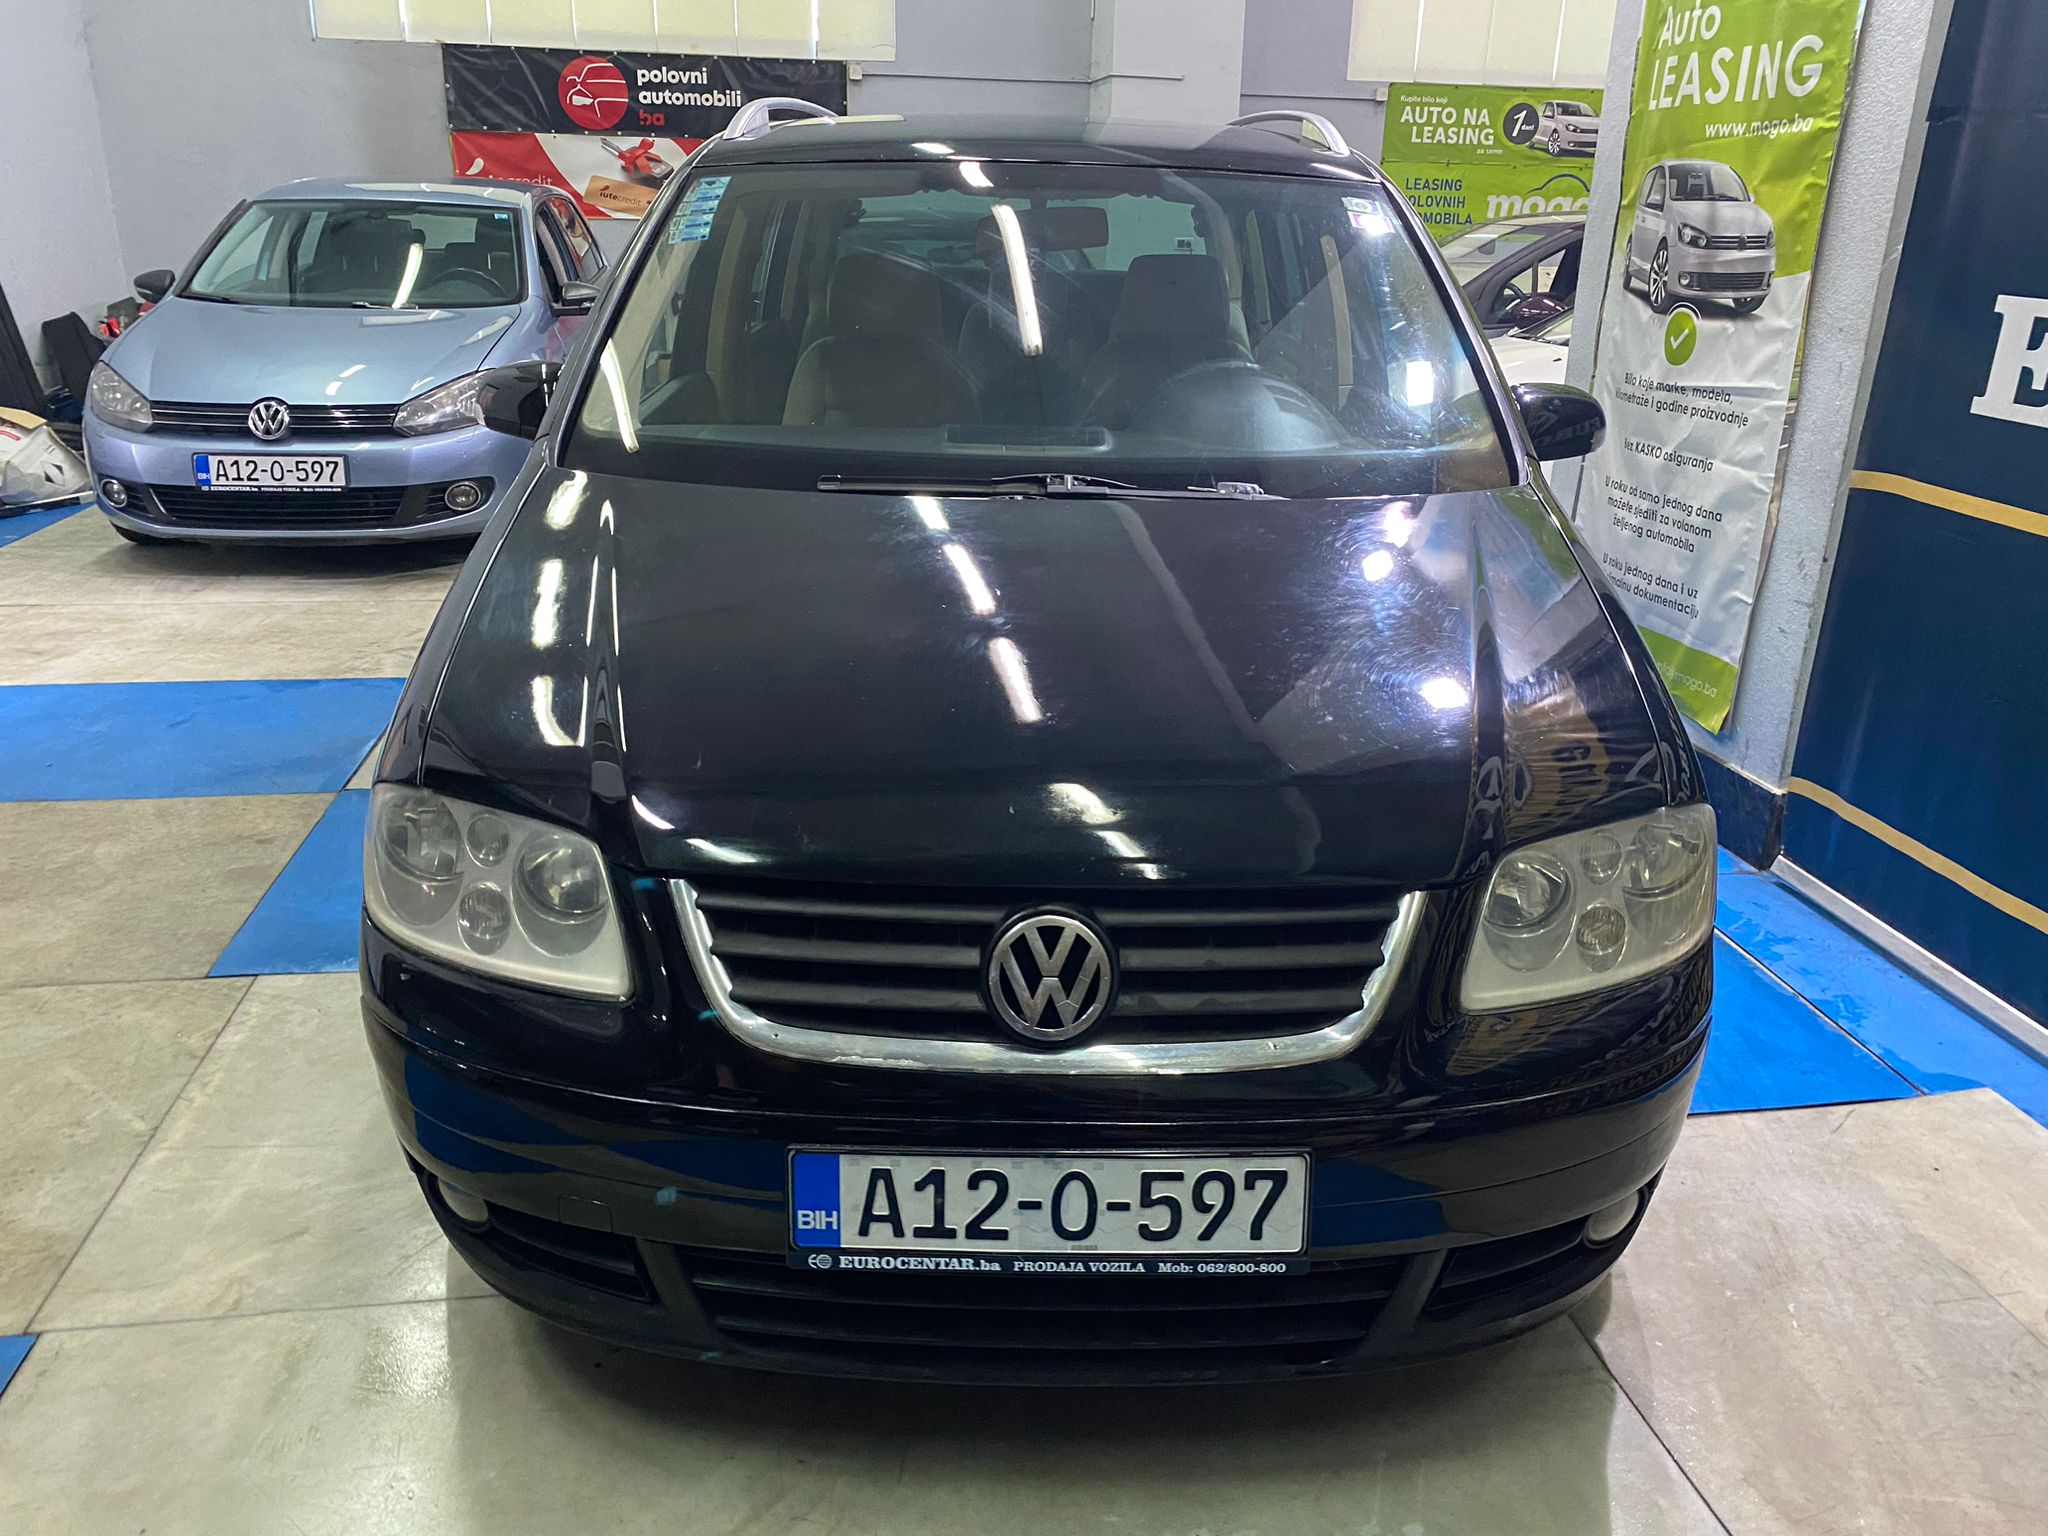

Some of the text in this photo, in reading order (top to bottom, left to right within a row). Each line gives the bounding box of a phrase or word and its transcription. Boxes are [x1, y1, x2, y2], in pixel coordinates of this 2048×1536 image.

[637, 66, 708, 86] polovni
[1648, 35, 1824, 110] LEASING
[638, 89, 742, 107] automobili
[1400, 106, 1490, 125] AUTO NA
[1511, 109, 1527, 137] 1
[1705, 114, 1814, 139] www.mogo.ba
[1411, 126, 1494, 146] LEASING
[1405, 177, 1463, 191] LEASING
[1408, 195, 1466, 209] OLOVNIH
[1638, 375, 1654, 391] koje
[1655, 381, 1689, 398] marke,
[1692, 387, 1733, 405] modela,
[1655, 399, 1689, 415] godine
[1690, 406, 1749, 428] proizvodnje
[1635, 441, 1662, 459] KASKO
[1663, 450, 1713, 473] osiguranja
[1610, 479, 1628, 493] roku
[1629, 486, 1638, 497] od
[1638, 489, 1660, 504] samo
[1662, 494, 1693, 517] jednog
[1695, 505, 1723, 522] dana
[1607, 496, 1712, 539] možete sjediti za volanom
[1613, 513, 1695, 552] željenog automobila
[1608, 556, 1623, 571] roku
[1623, 562, 1653, 586] jednog
[1655, 574, 1679, 593] dana
[1687, 587, 1699, 600] uz
[1633, 584, 1699, 619] dokumentaciju
[797, 1209, 838, 1230] BIH
[838, 1255, 1287, 1273] EUROCENTAR.ba PRODAJA VOZILA Mob: 062/800-800
